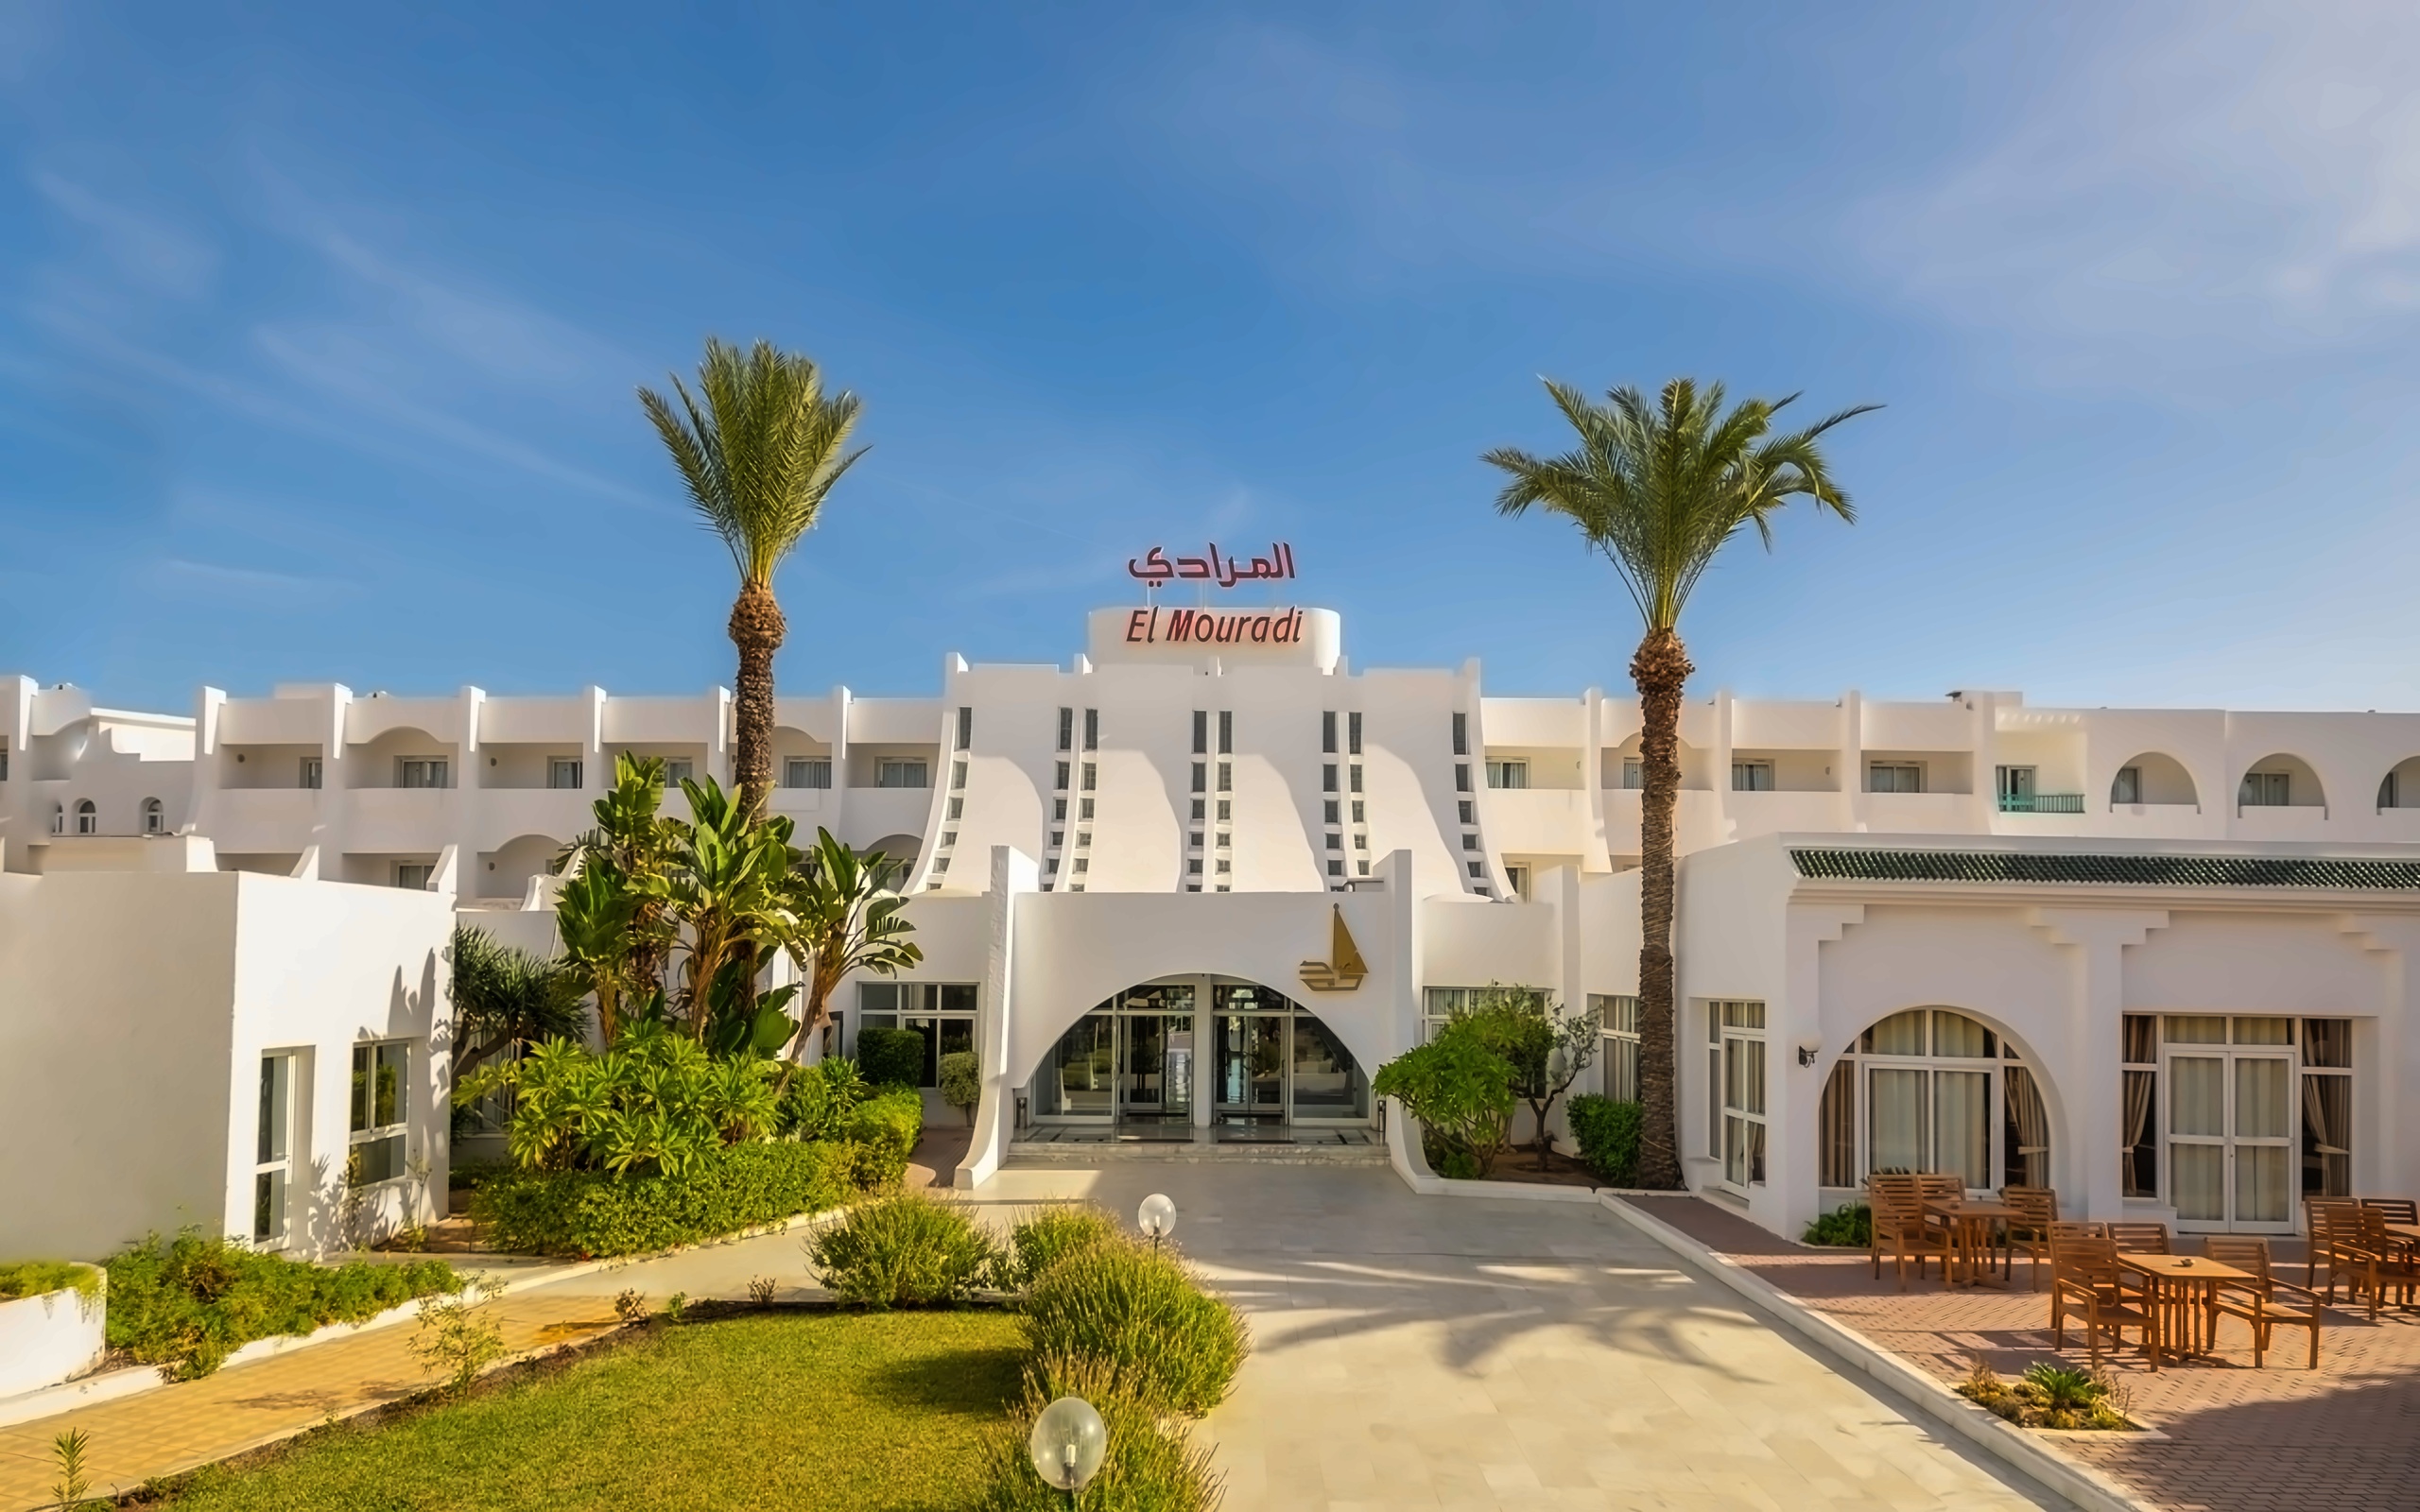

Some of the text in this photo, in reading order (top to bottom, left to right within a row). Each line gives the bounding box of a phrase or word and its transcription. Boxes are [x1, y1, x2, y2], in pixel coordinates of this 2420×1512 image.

[1129, 541, 1295, 587] المرادي
[1126, 606, 1303, 644] El Mouradi
